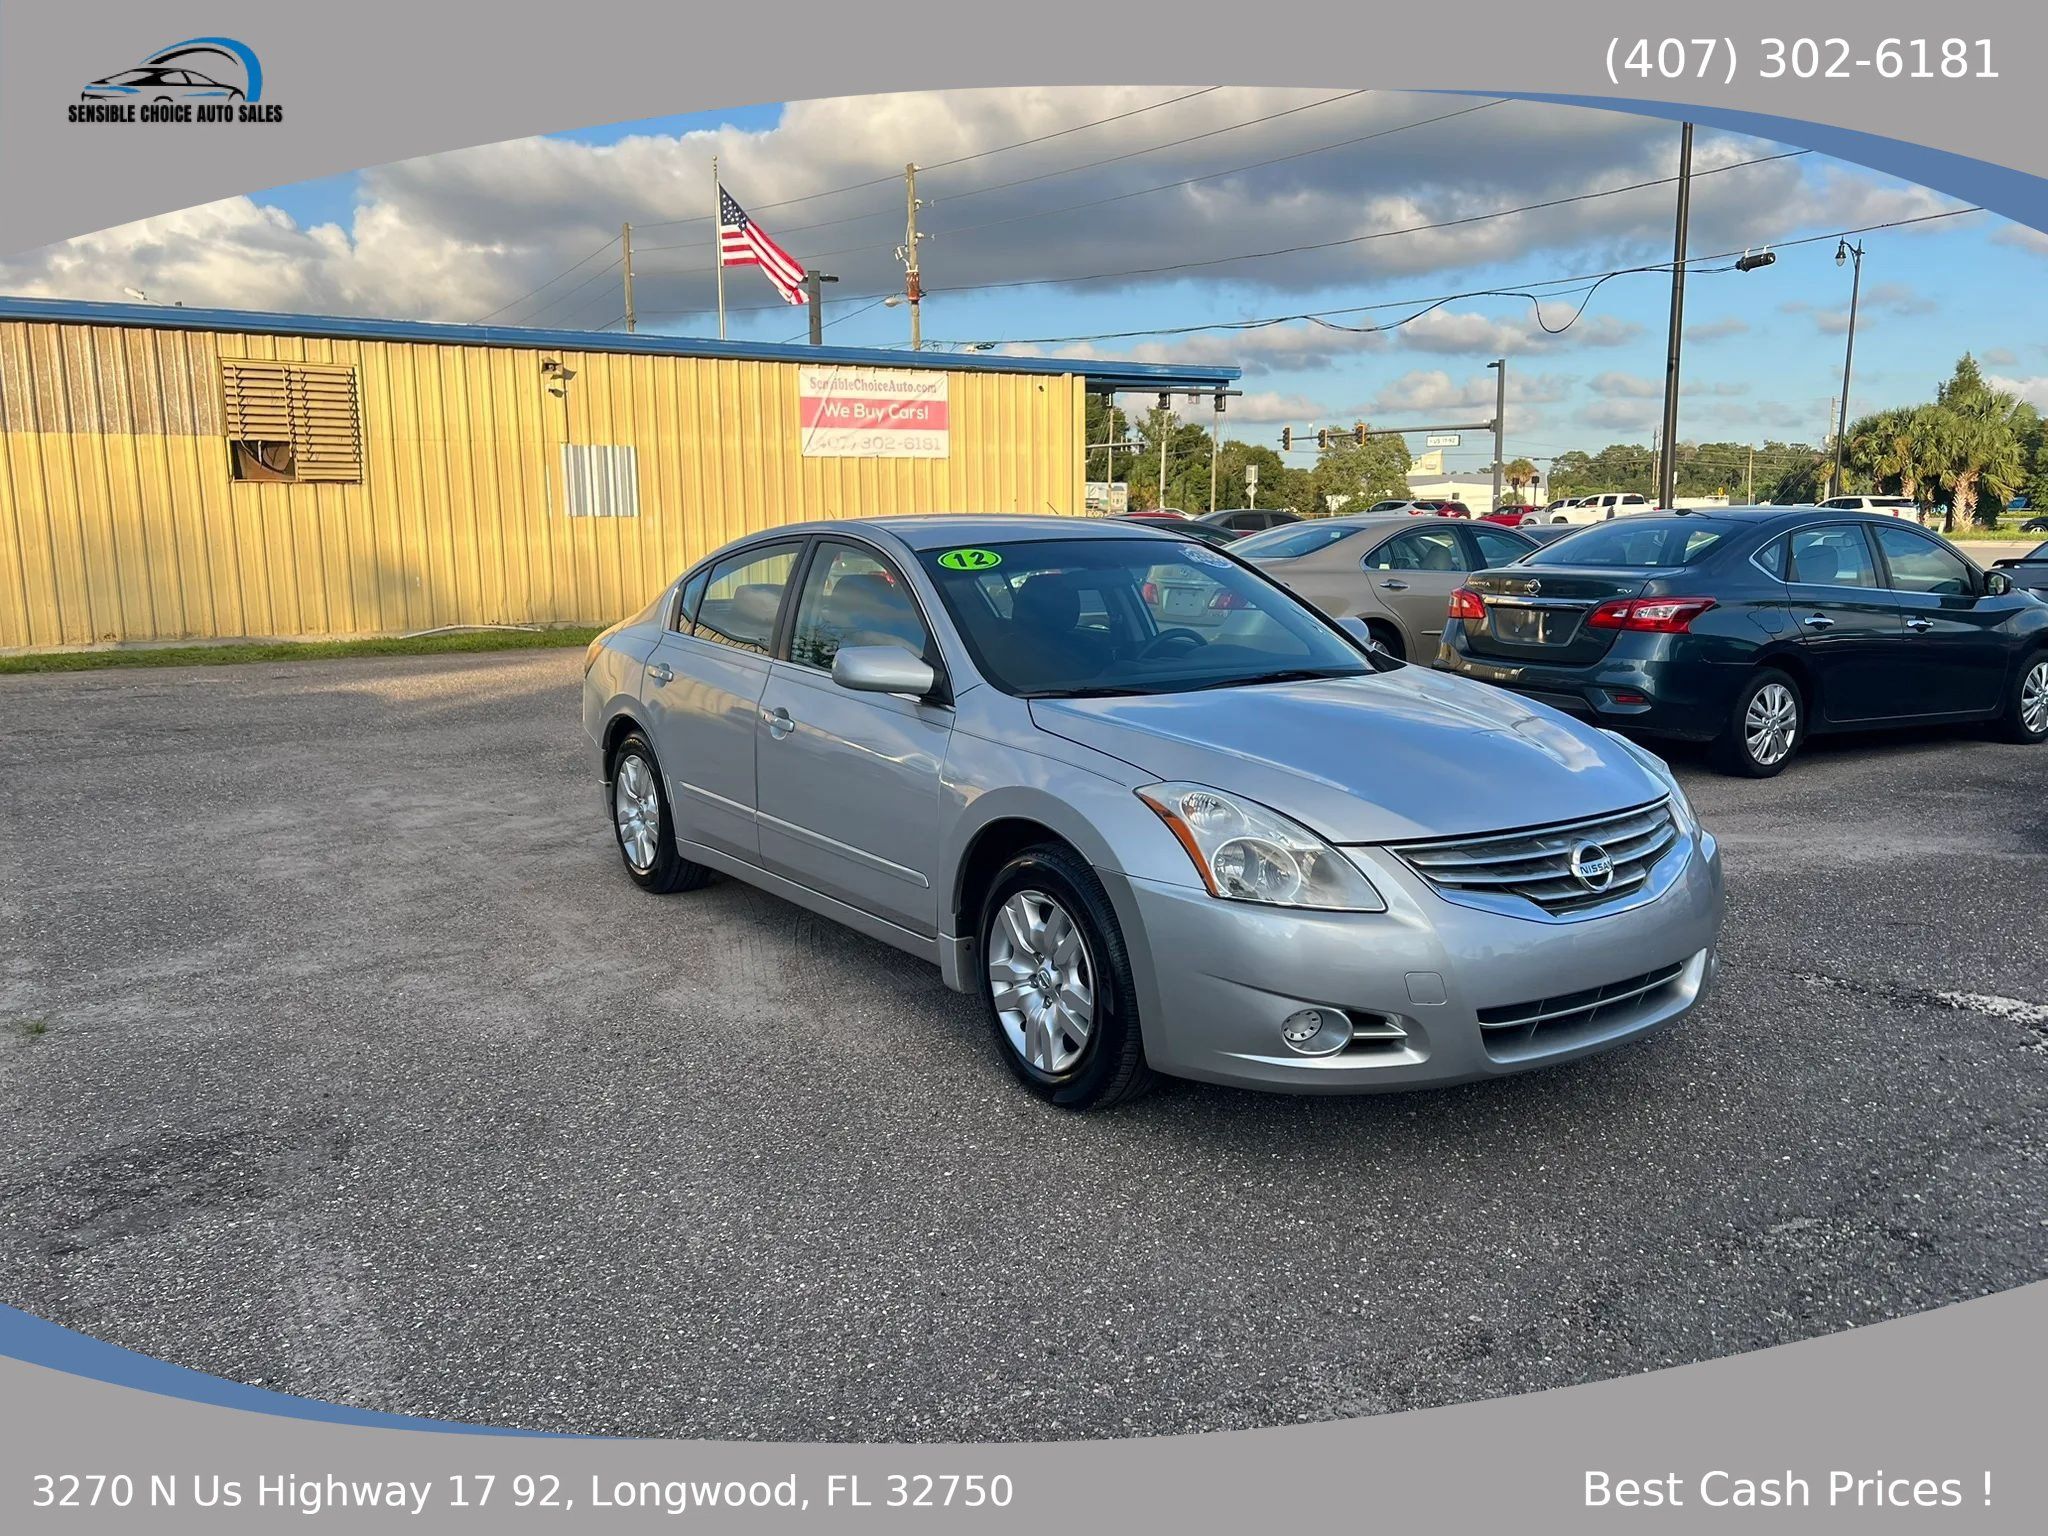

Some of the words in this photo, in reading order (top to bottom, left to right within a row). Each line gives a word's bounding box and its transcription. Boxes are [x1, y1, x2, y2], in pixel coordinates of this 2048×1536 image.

[809, 377, 937, 393] SenibleChoiceAuto.com
[824, 402, 850, 418] We
[854, 404, 885, 423] Buy
[888, 404, 929, 420] Cars!
[861, 435, 941, 451] 302-6181
[953, 551, 989, 567] 12
